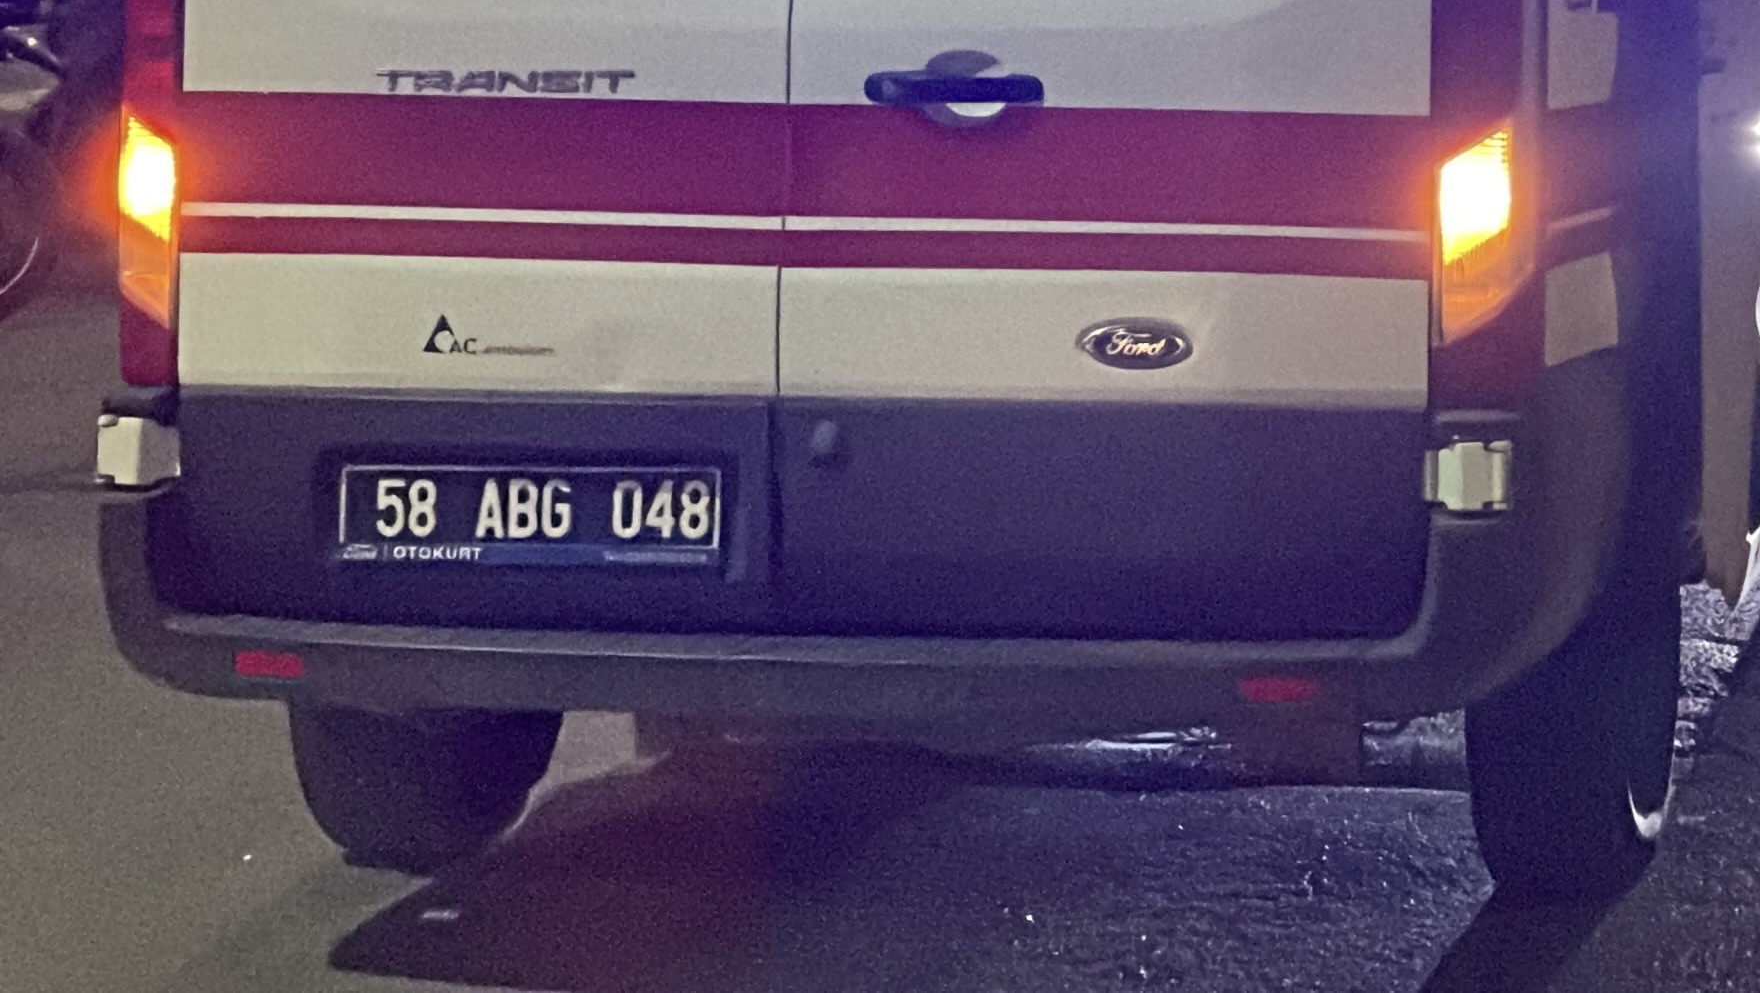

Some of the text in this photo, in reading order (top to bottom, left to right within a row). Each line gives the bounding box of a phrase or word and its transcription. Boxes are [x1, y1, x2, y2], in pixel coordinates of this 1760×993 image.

[376, 69, 635, 94] TRANSIT
[1106, 329, 1166, 356] Ford
[375, 478, 710, 539] 58 ABG 048
[393, 545, 482, 561] OTOKURT
